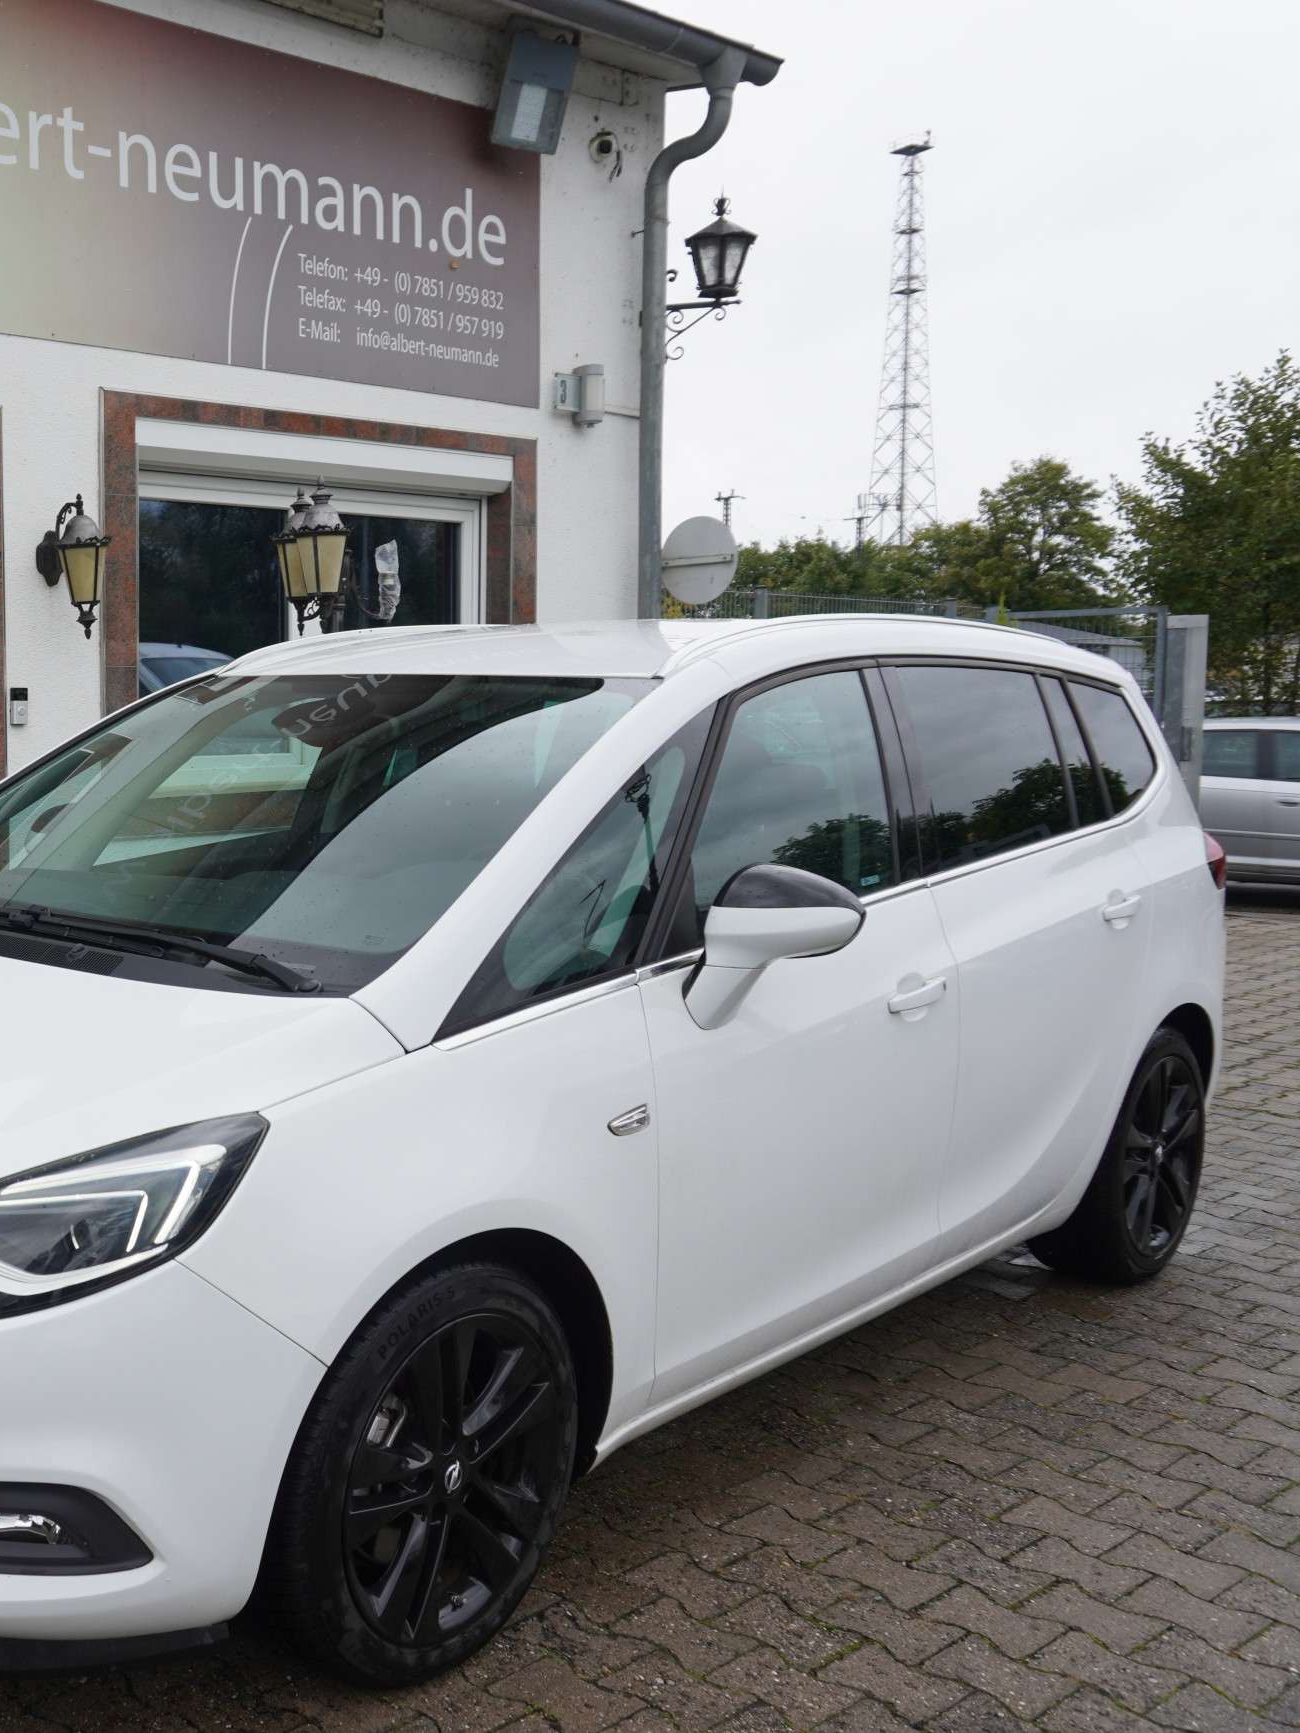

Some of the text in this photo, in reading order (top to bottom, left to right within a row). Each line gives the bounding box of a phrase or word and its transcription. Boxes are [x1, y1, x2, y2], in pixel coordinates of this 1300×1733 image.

[297, 253, 348, 281] Telefon:
[354, 267, 381, 287] +49
[394, 271, 411, 296] (0)
[414, 275, 444, 299] 7851
[456, 283, 479, 305] 959
[481, 288, 504, 310] 832
[297, 285, 346, 313] Telefax:
[354, 299, 381, 318] +49
[394, 303, 411, 327] (0)
[414, 307, 444, 330] 7851
[456, 314, 479, 335] 957
[481, 319, 504, 340] 919
[298, 318, 500, 368] E-Mail: info@albert-neumann.de
[559, 379, 568, 404] 3
